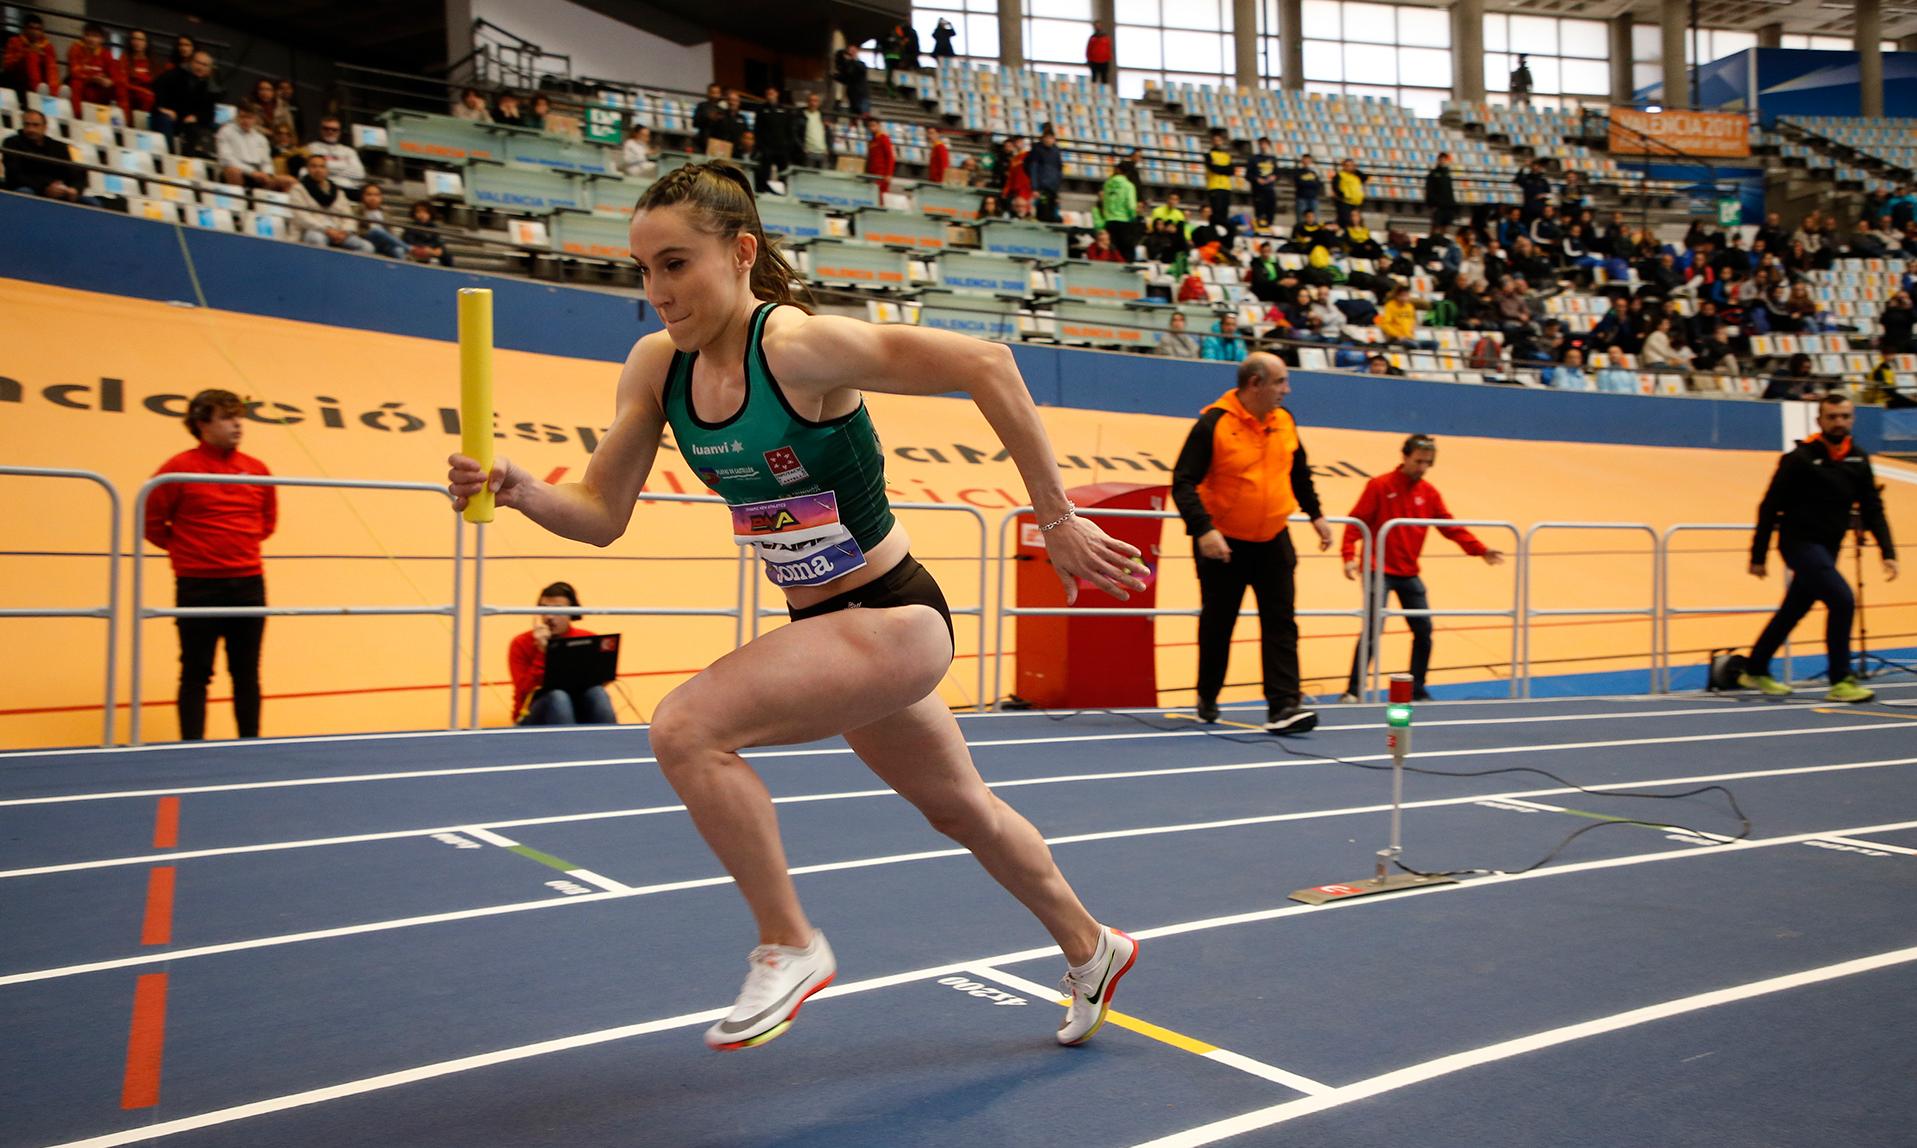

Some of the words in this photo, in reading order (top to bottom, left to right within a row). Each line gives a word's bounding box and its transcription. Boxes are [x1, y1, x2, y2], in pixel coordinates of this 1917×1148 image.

[944, 276, 997, 289] VALENCIA
[927, 318, 985, 332] VALENCIA
[692, 442, 729, 456] luanvi
